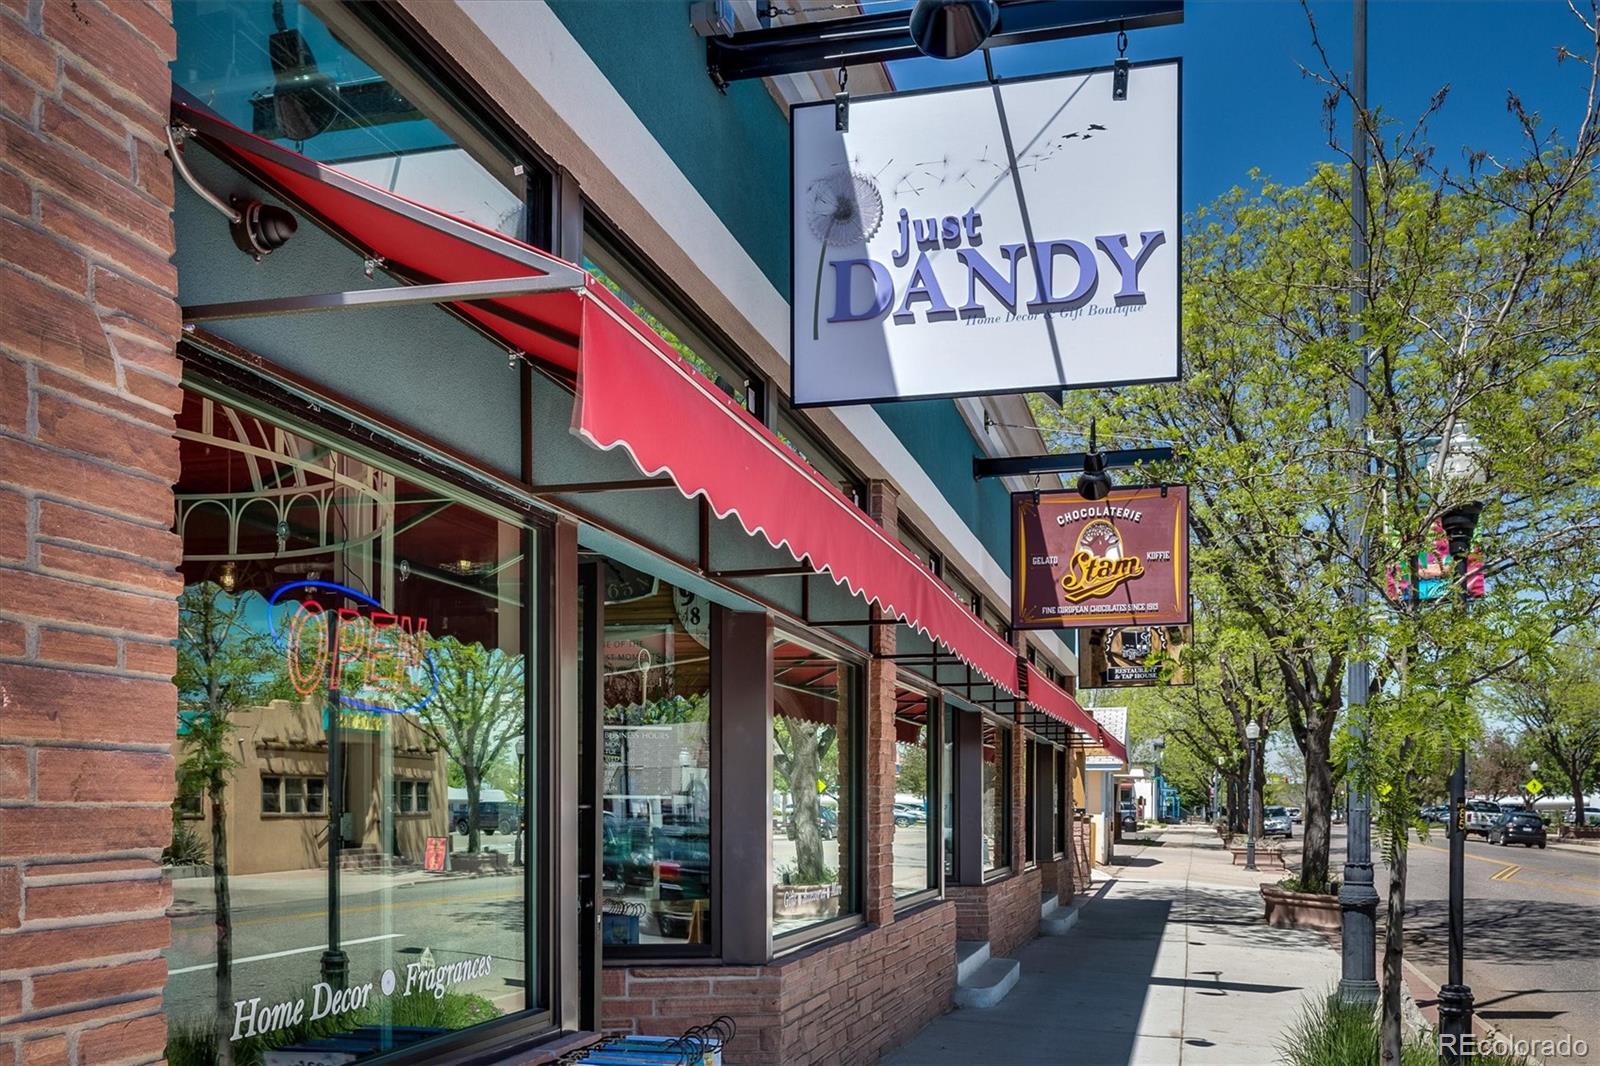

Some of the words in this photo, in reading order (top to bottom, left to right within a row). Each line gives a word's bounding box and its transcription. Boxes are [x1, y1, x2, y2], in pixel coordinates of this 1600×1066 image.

[892, 208, 982, 267] just
[827, 231, 1166, 326] DANDY
[965, 314, 1001, 326] Home
[1005, 311, 1039, 323] Decor
[1044, 308, 1054, 320] &
[1060, 306, 1084, 321] Gift
[1088, 303, 1144, 317] Boutique
[1056, 506, 1143, 528] CHOCOLATERIE
[1032, 555, 1058, 566] GELATO
[1146, 550, 1170, 561] KOFFIE
[1061, 552, 1145, 593] Stam
[690, 607, 700, 625] 8
[1042, 606, 1056, 614] FINE
[1057, 605, 1089, 615] EUROPEAN
[1089, 604, 1127, 613] CHOCOLATES
[1128, 603, 1145, 612] SINCE
[287, 599, 428, 695] OPEN
[605, 732, 640, 740] BUSINESS
[230, 997, 305, 1042] Home
[310, 982, 373, 1021] Decor
[403, 953, 492, 999] Fragrances
